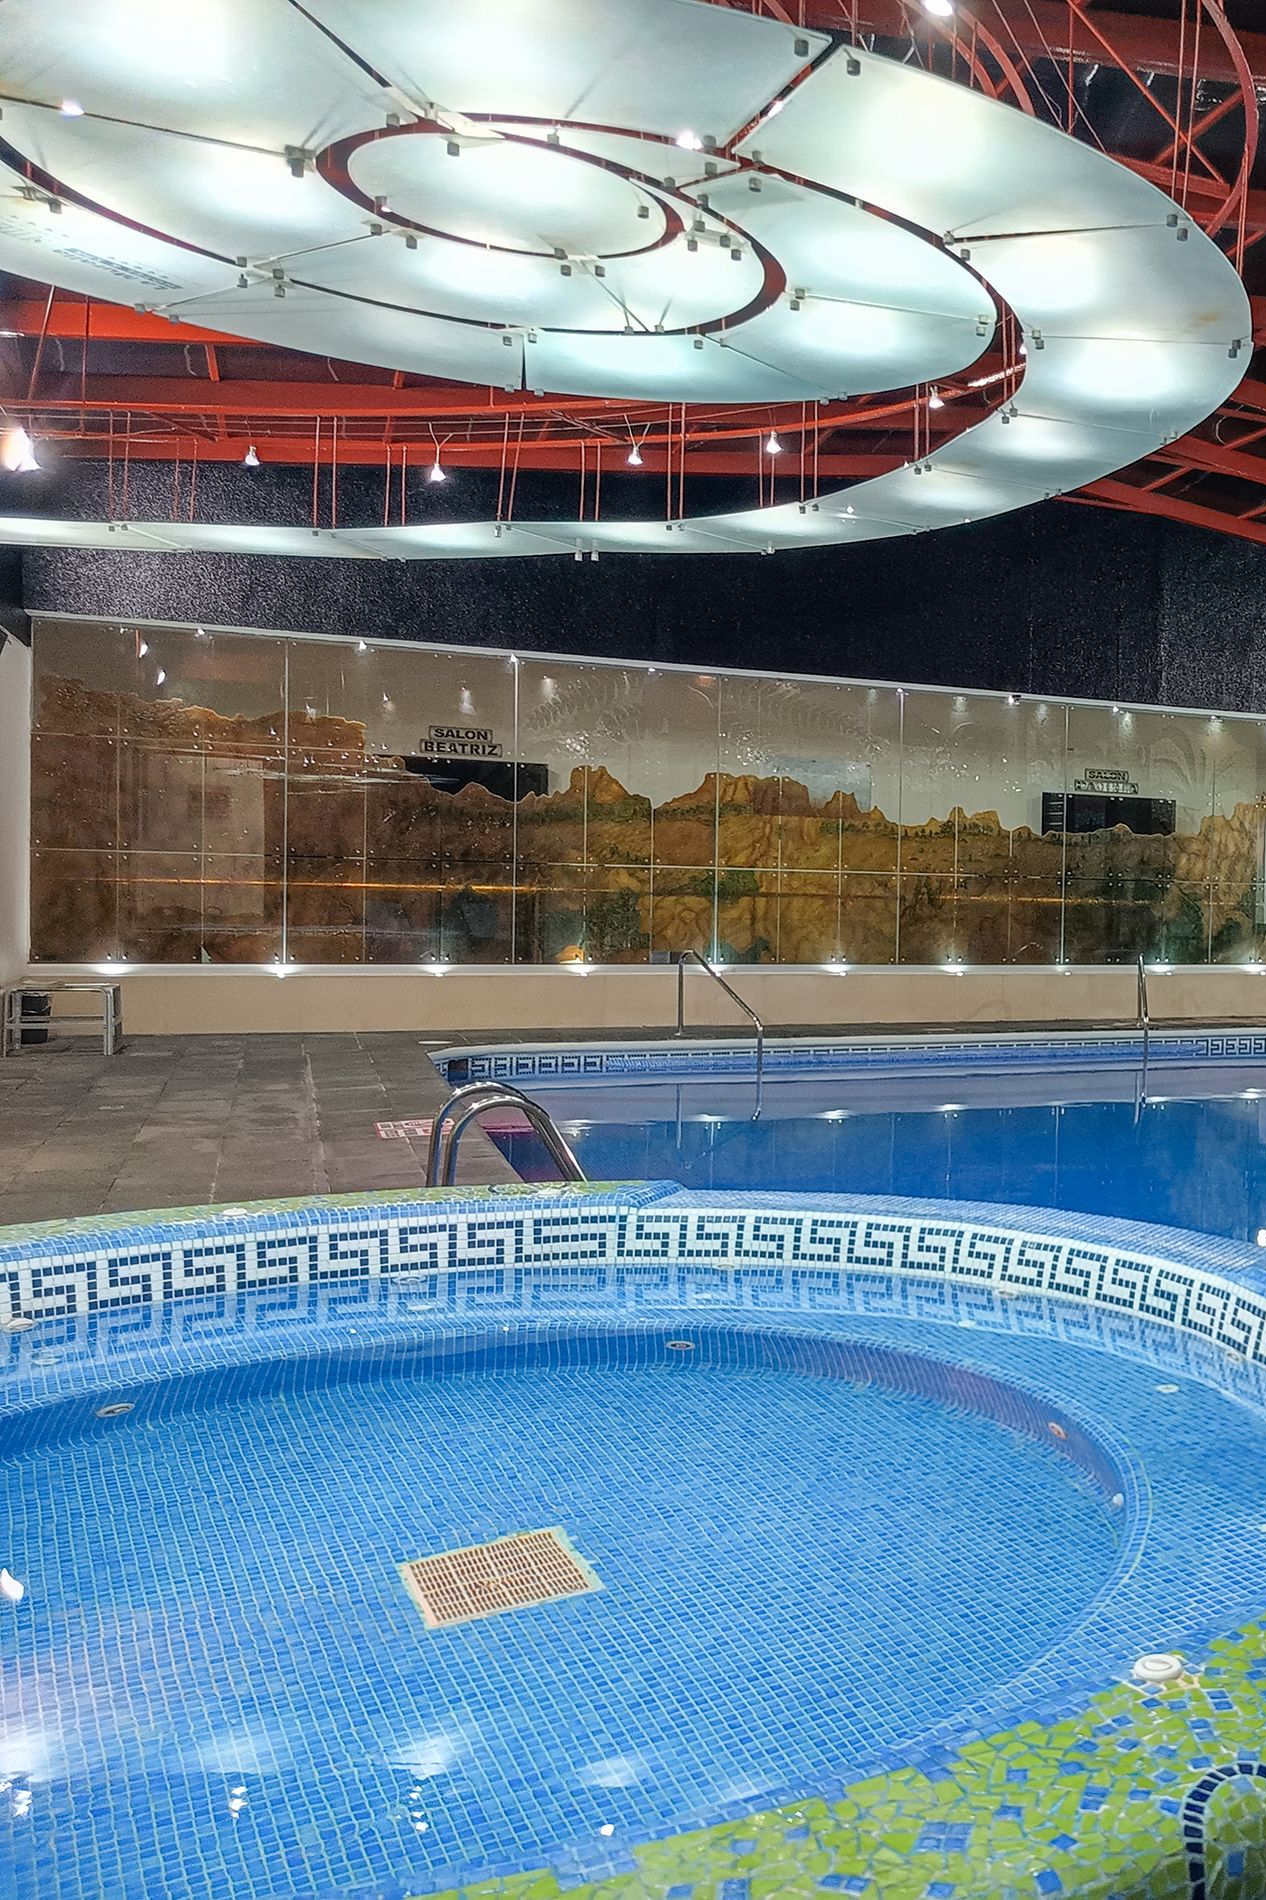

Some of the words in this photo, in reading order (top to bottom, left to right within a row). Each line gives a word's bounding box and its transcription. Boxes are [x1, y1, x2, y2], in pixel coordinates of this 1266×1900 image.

[433, 728, 488, 741] SALON
[424, 741, 499, 756] BEATRIZ
[1088, 770, 1126, 781] SALON
